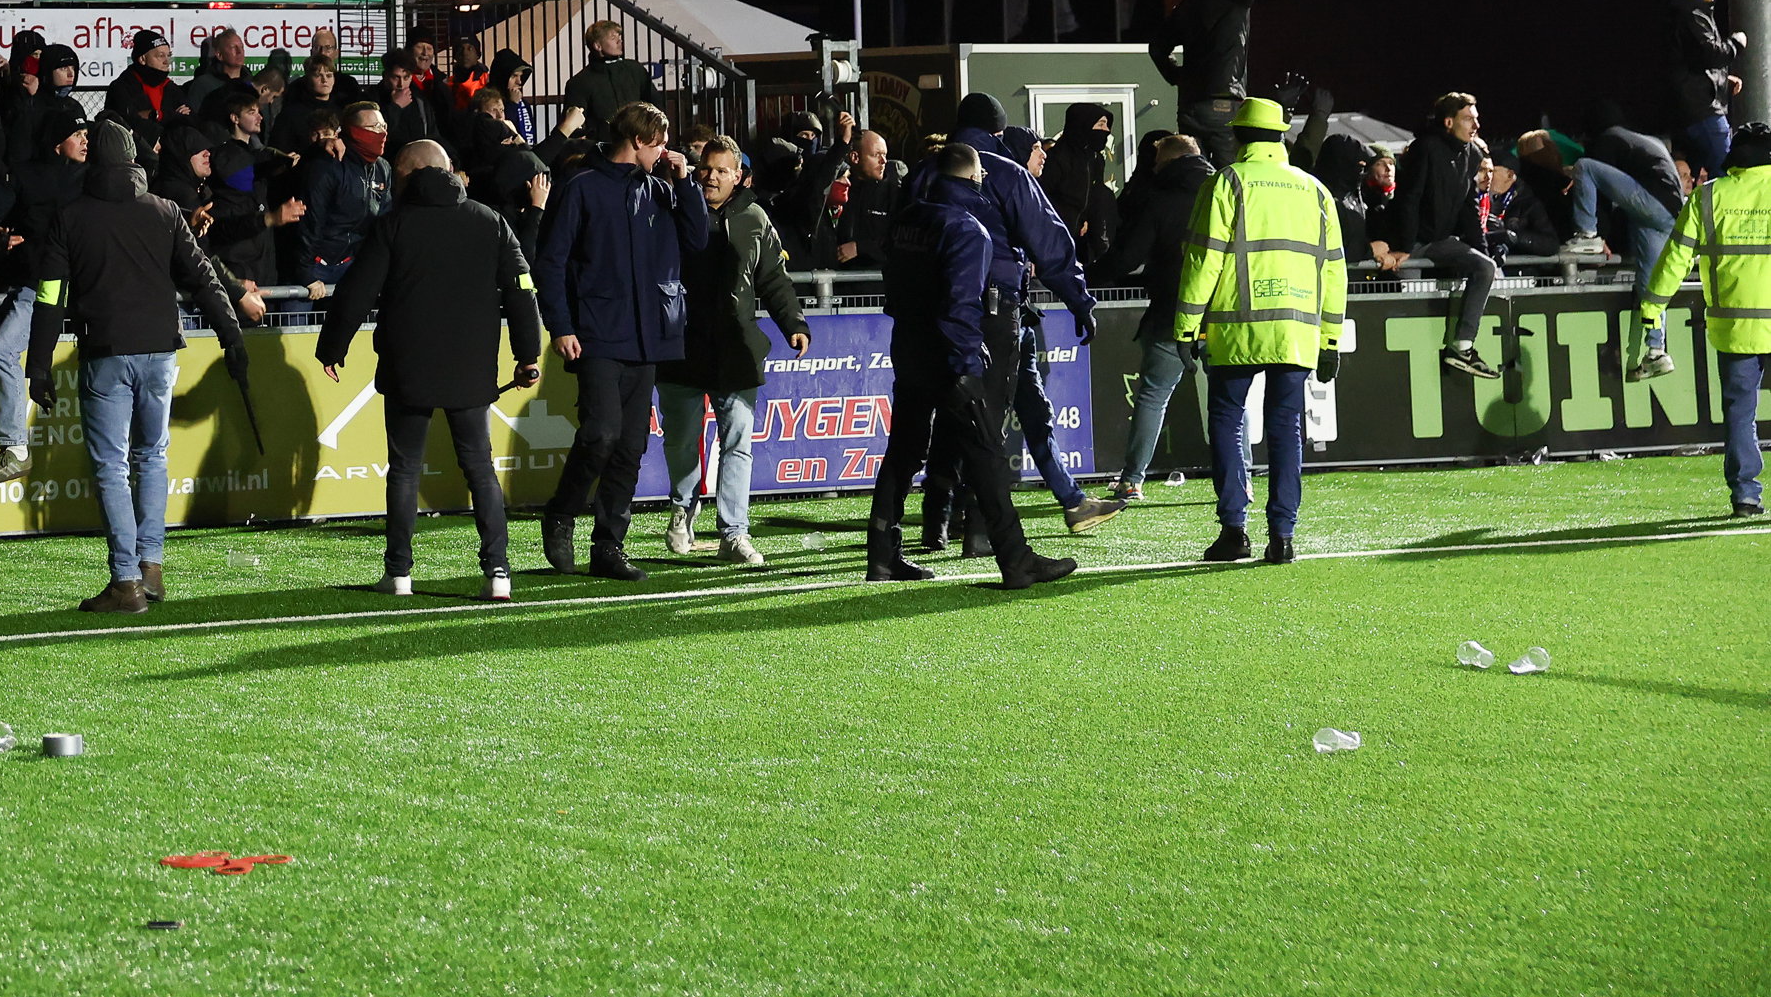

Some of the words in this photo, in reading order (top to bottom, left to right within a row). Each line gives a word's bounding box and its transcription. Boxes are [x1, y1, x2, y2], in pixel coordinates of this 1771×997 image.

[73, 17, 175, 49] afhl
[243, 18, 375, 55] cateng
[1248, 180, 1293, 190] STEWARD
[763, 354, 862, 375] ransport,
[776, 457, 828, 483] en
[30, 479, 59, 502] 29
